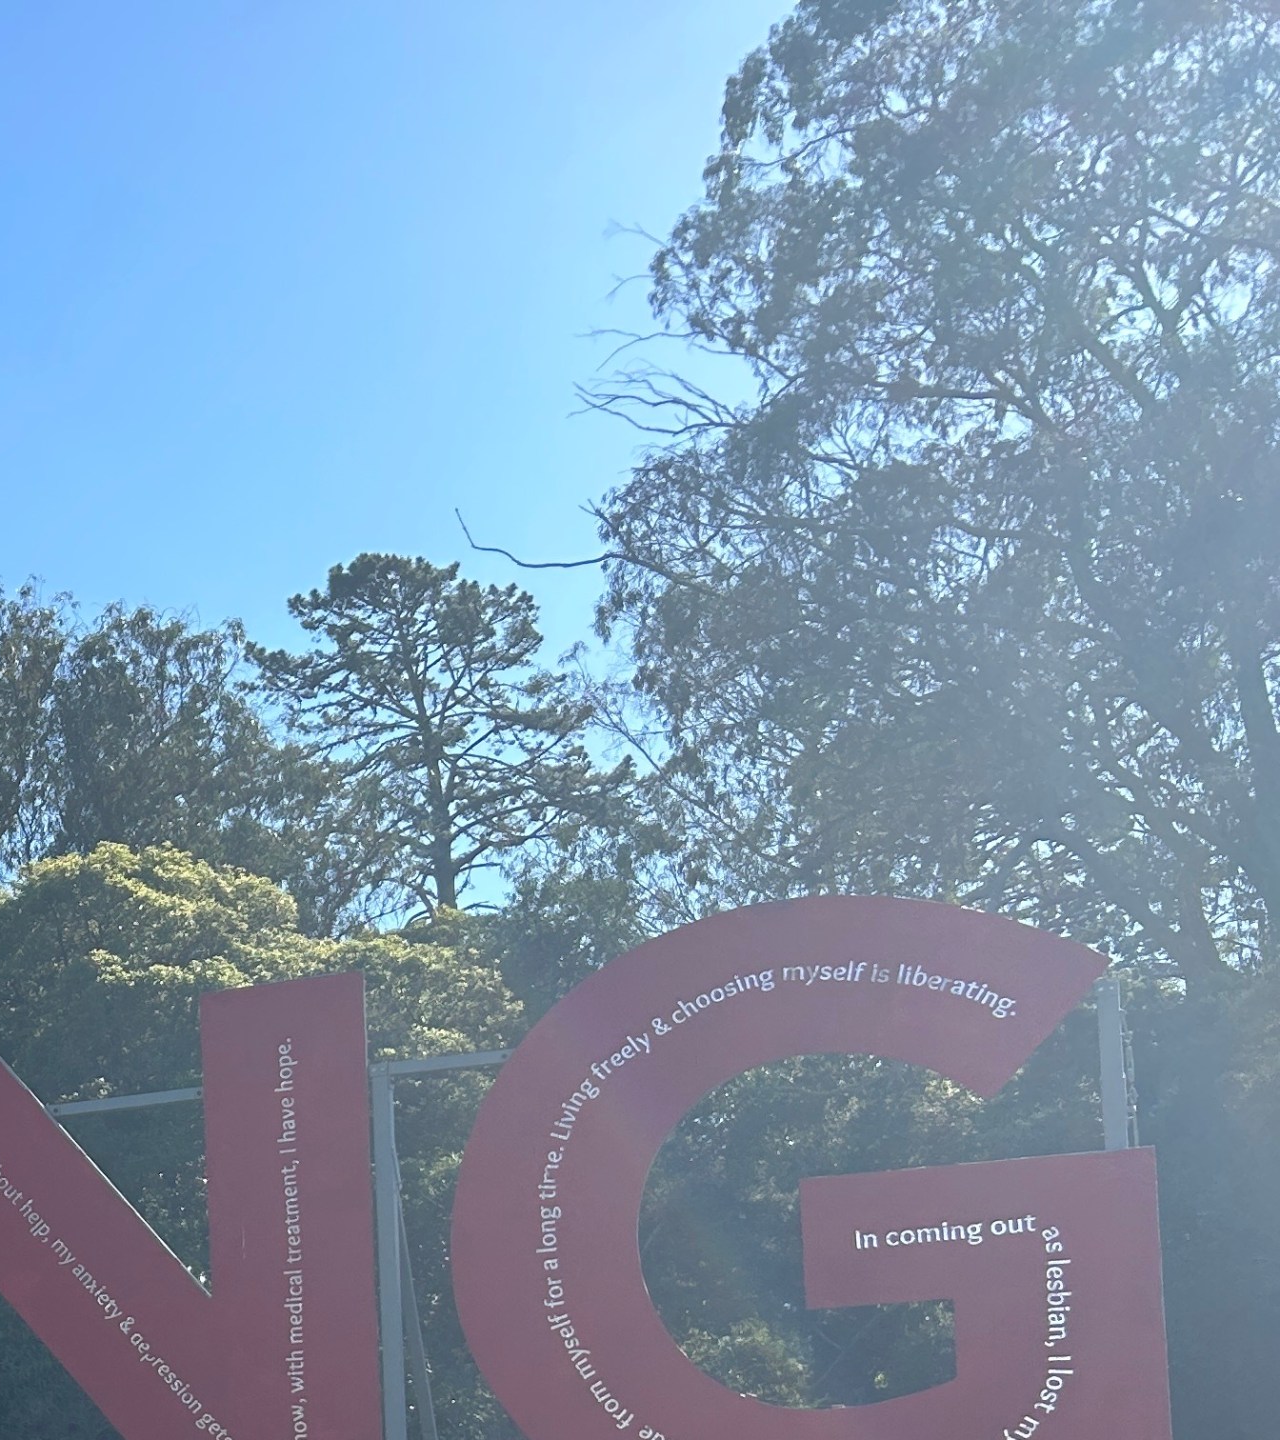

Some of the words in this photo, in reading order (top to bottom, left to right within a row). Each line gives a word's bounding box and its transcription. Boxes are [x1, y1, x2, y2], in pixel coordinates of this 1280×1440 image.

[671, 969, 775, 1024] choosing
[782, 960, 868, 986] myself
[870, 962, 890, 984] is
[896, 963, 1017, 1019] liberating.
[650, 1017, 673, 1036] &
[273, 1037, 299, 1093] hope.
[590, 1032, 650, 1080] freely
[276, 1097, 297, 1143] have
[549, 1077, 601, 1141] Living
[280, 1159, 302, 1264] treatment,
[535, 1205, 562, 1254] long
[885, 1221, 983, 1247] coming
[990, 1214, 1036, 1236] out
[854, 1229, 878, 1250] In
[1041, 1225, 1063, 1253] as
[50, 1237, 77, 1265] my
[71, 1263, 123, 1320] anxiety
[118, 1316, 135, 1335] &
[543, 1257, 559, 1271] a
[282, 1269, 304, 1344] medical
[543, 1276, 565, 1309] for
[1043, 1258, 1072, 1347] lesbian,
[546, 1313, 596, 1380] myself
[284, 1349, 305, 1394] with
[1033, 1368, 1074, 1414] lost
[589, 1379, 634, 1430] from
